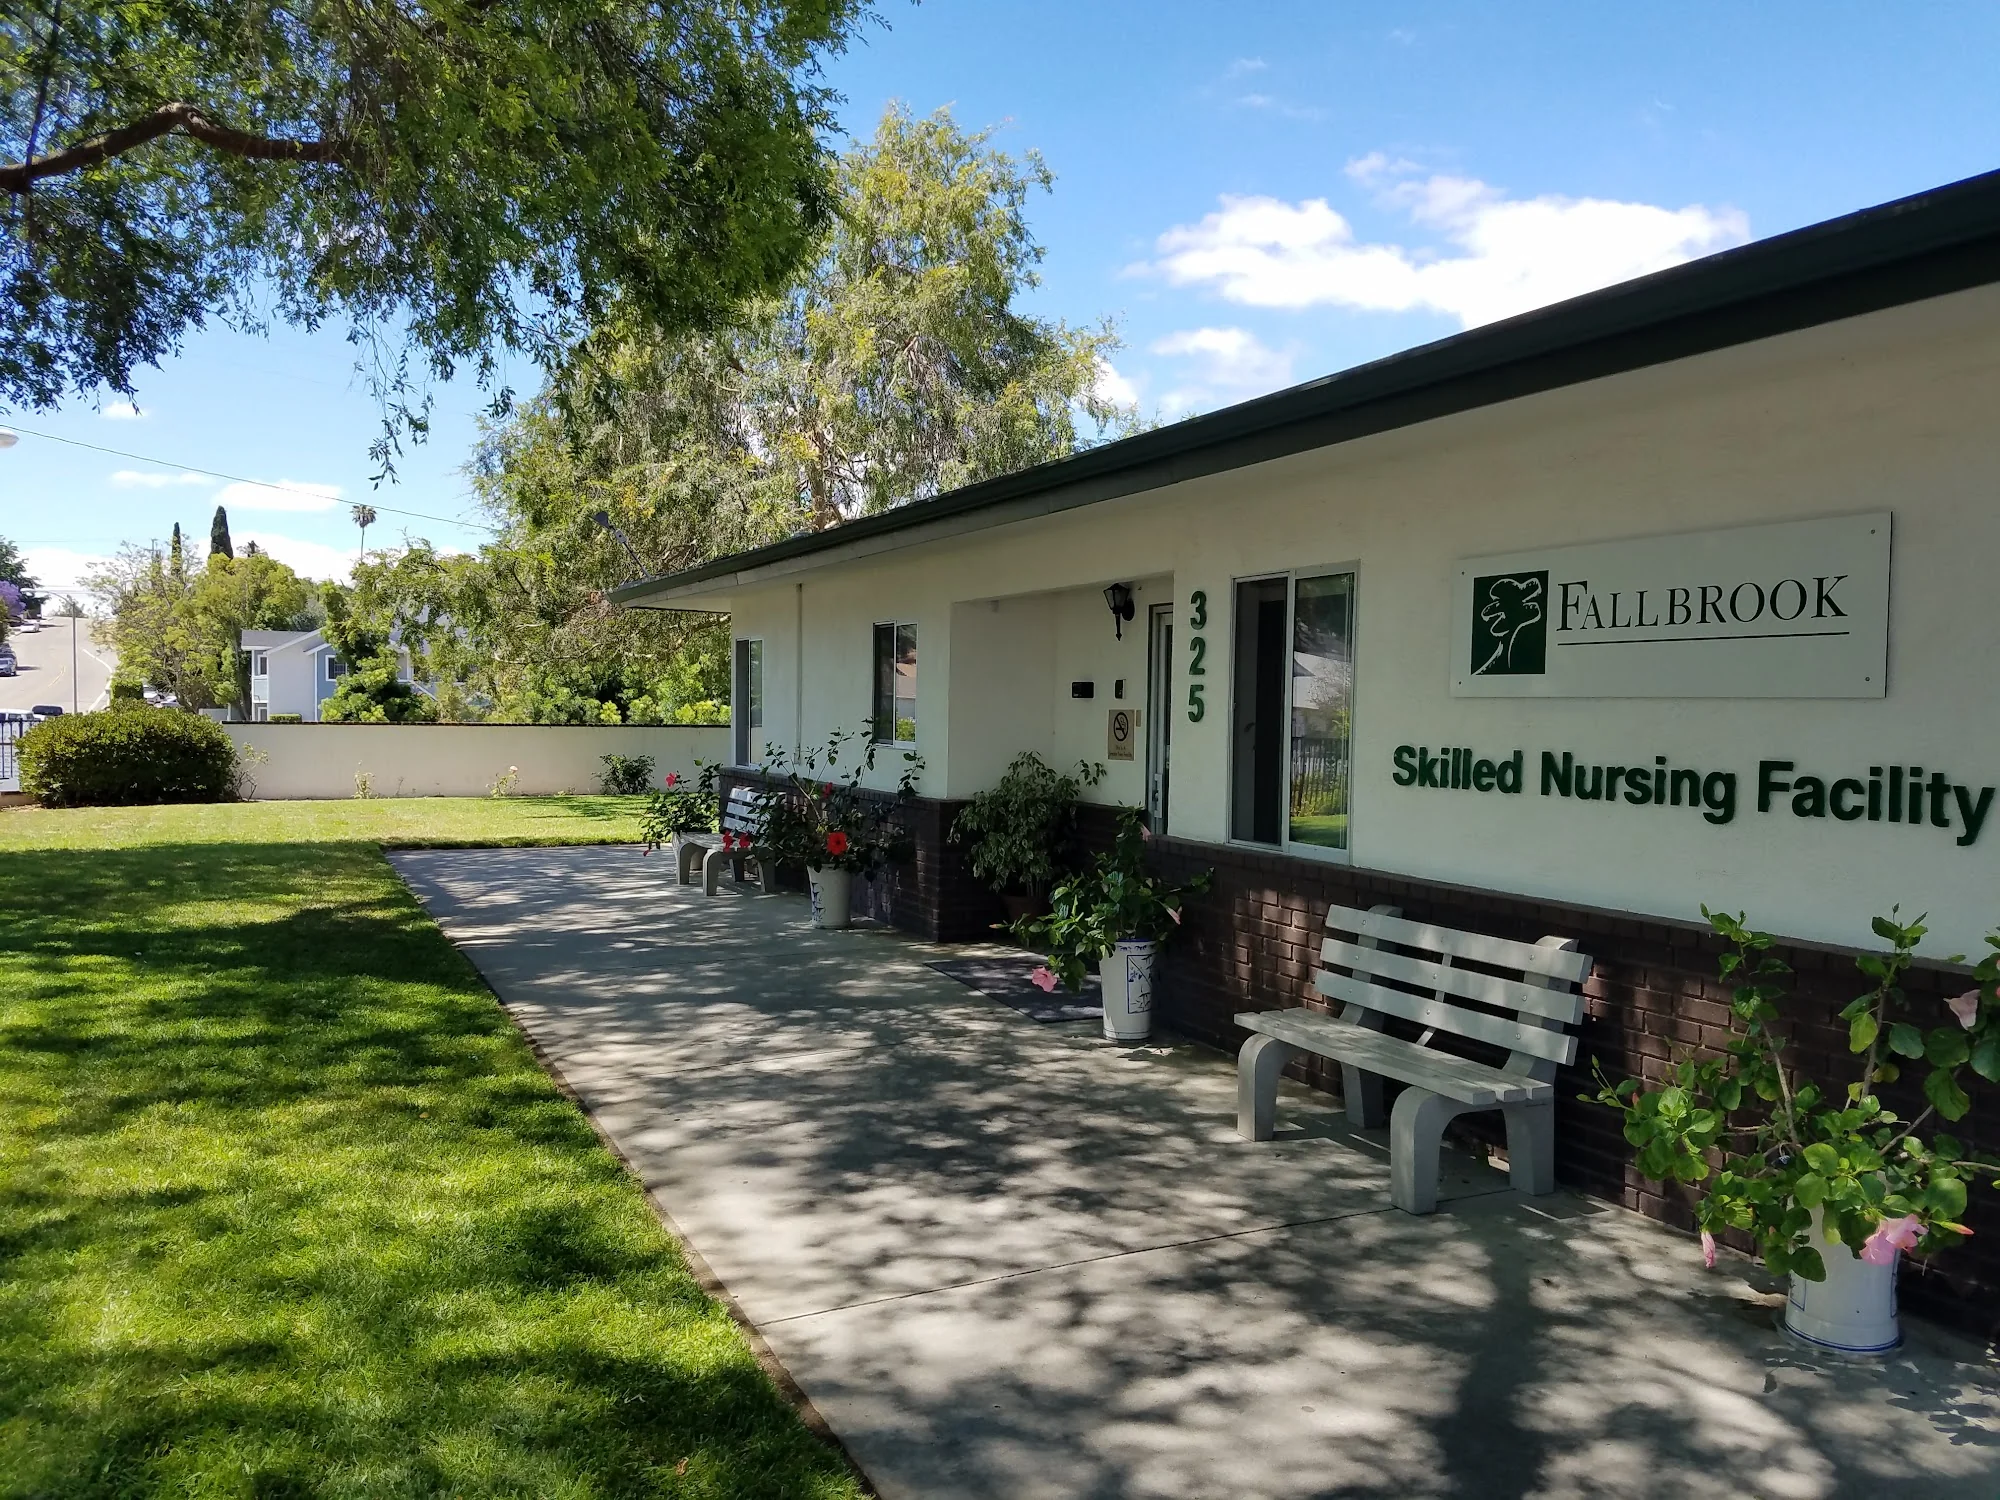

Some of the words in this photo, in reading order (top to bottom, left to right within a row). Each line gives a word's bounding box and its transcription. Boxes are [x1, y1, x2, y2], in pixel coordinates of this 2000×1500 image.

[1556, 575, 1848, 632] FALLBROOK
[1187, 590, 1208, 723] 325
[1392, 744, 1524, 794] Skilled
[1540, 751, 1739, 825] Nursing
[1757, 760, 1996, 846] Facility
